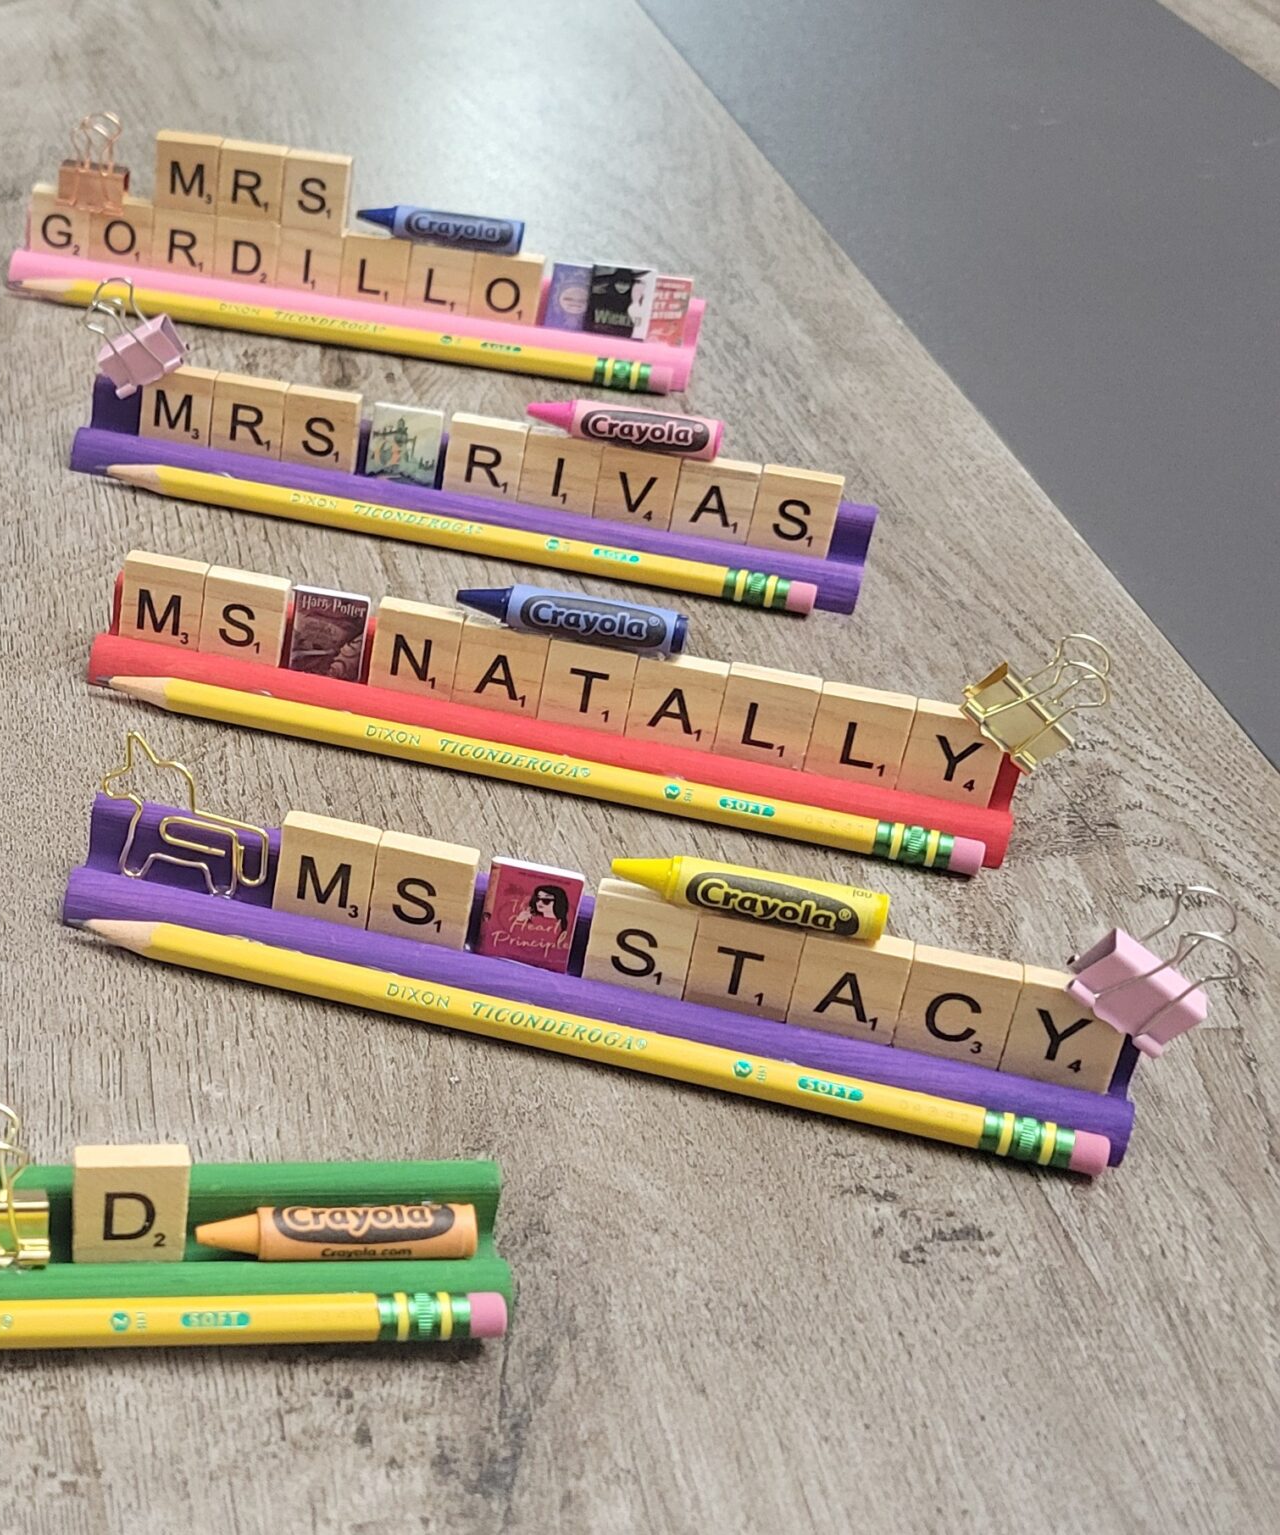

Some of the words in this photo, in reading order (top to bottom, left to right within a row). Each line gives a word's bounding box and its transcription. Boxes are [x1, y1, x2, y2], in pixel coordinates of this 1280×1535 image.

[170, 161, 327, 214] MRS
[42, 214, 520, 312] GORDILLO
[153, 389, 335, 457] MRS
[464, 444, 811, 540] RIVAS
[302, 595, 332, 611] Harry
[333, 598, 367, 617] Potter
[136, 589, 255, 648] MS
[390, 634, 984, 781] NATALLY
[366, 725, 420, 745] DIXON
[296, 855, 437, 925] MS
[611, 929, 1092, 1060] STACY
[491, 930, 569, 958] Principle
[387, 983, 450, 1008] DIXON
[806, 1078, 854, 1099] SOFT
[104, 1192, 156, 1241] D
[320, 1247, 413, 1258] Crayola.com
[190, 1313, 239, 1328] SOFT
